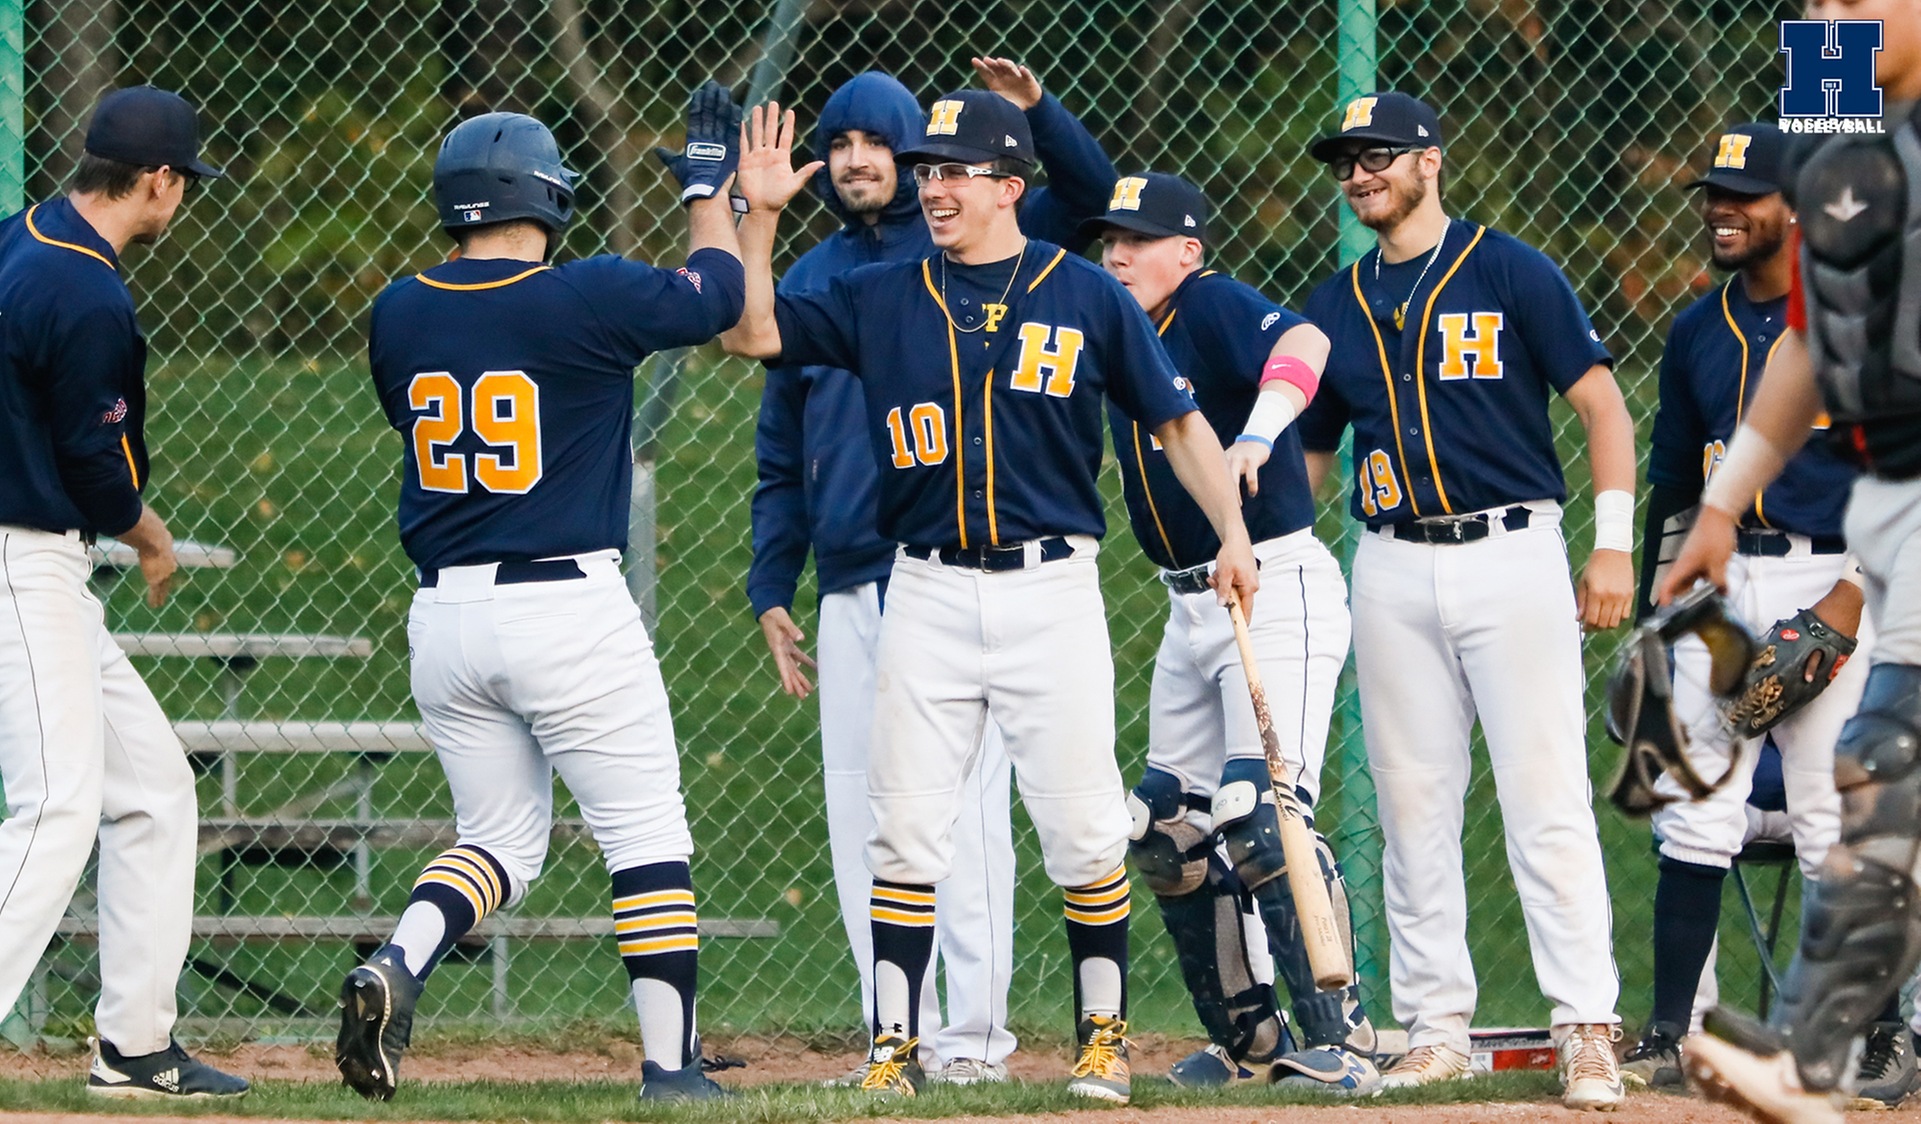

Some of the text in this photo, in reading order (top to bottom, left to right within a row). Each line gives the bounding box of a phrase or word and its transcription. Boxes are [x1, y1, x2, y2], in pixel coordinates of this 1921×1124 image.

[926, 100, 965, 136] H
[1341, 97, 1378, 133] H
[1714, 134, 1752, 170] H
[1109, 177, 1148, 212] H
[1010, 322, 1084, 398] H
[1438, 312, 1504, 381] H
[407, 370, 543, 495] 29
[886, 401, 949, 469] 10
[1359, 448, 1403, 517] 19
